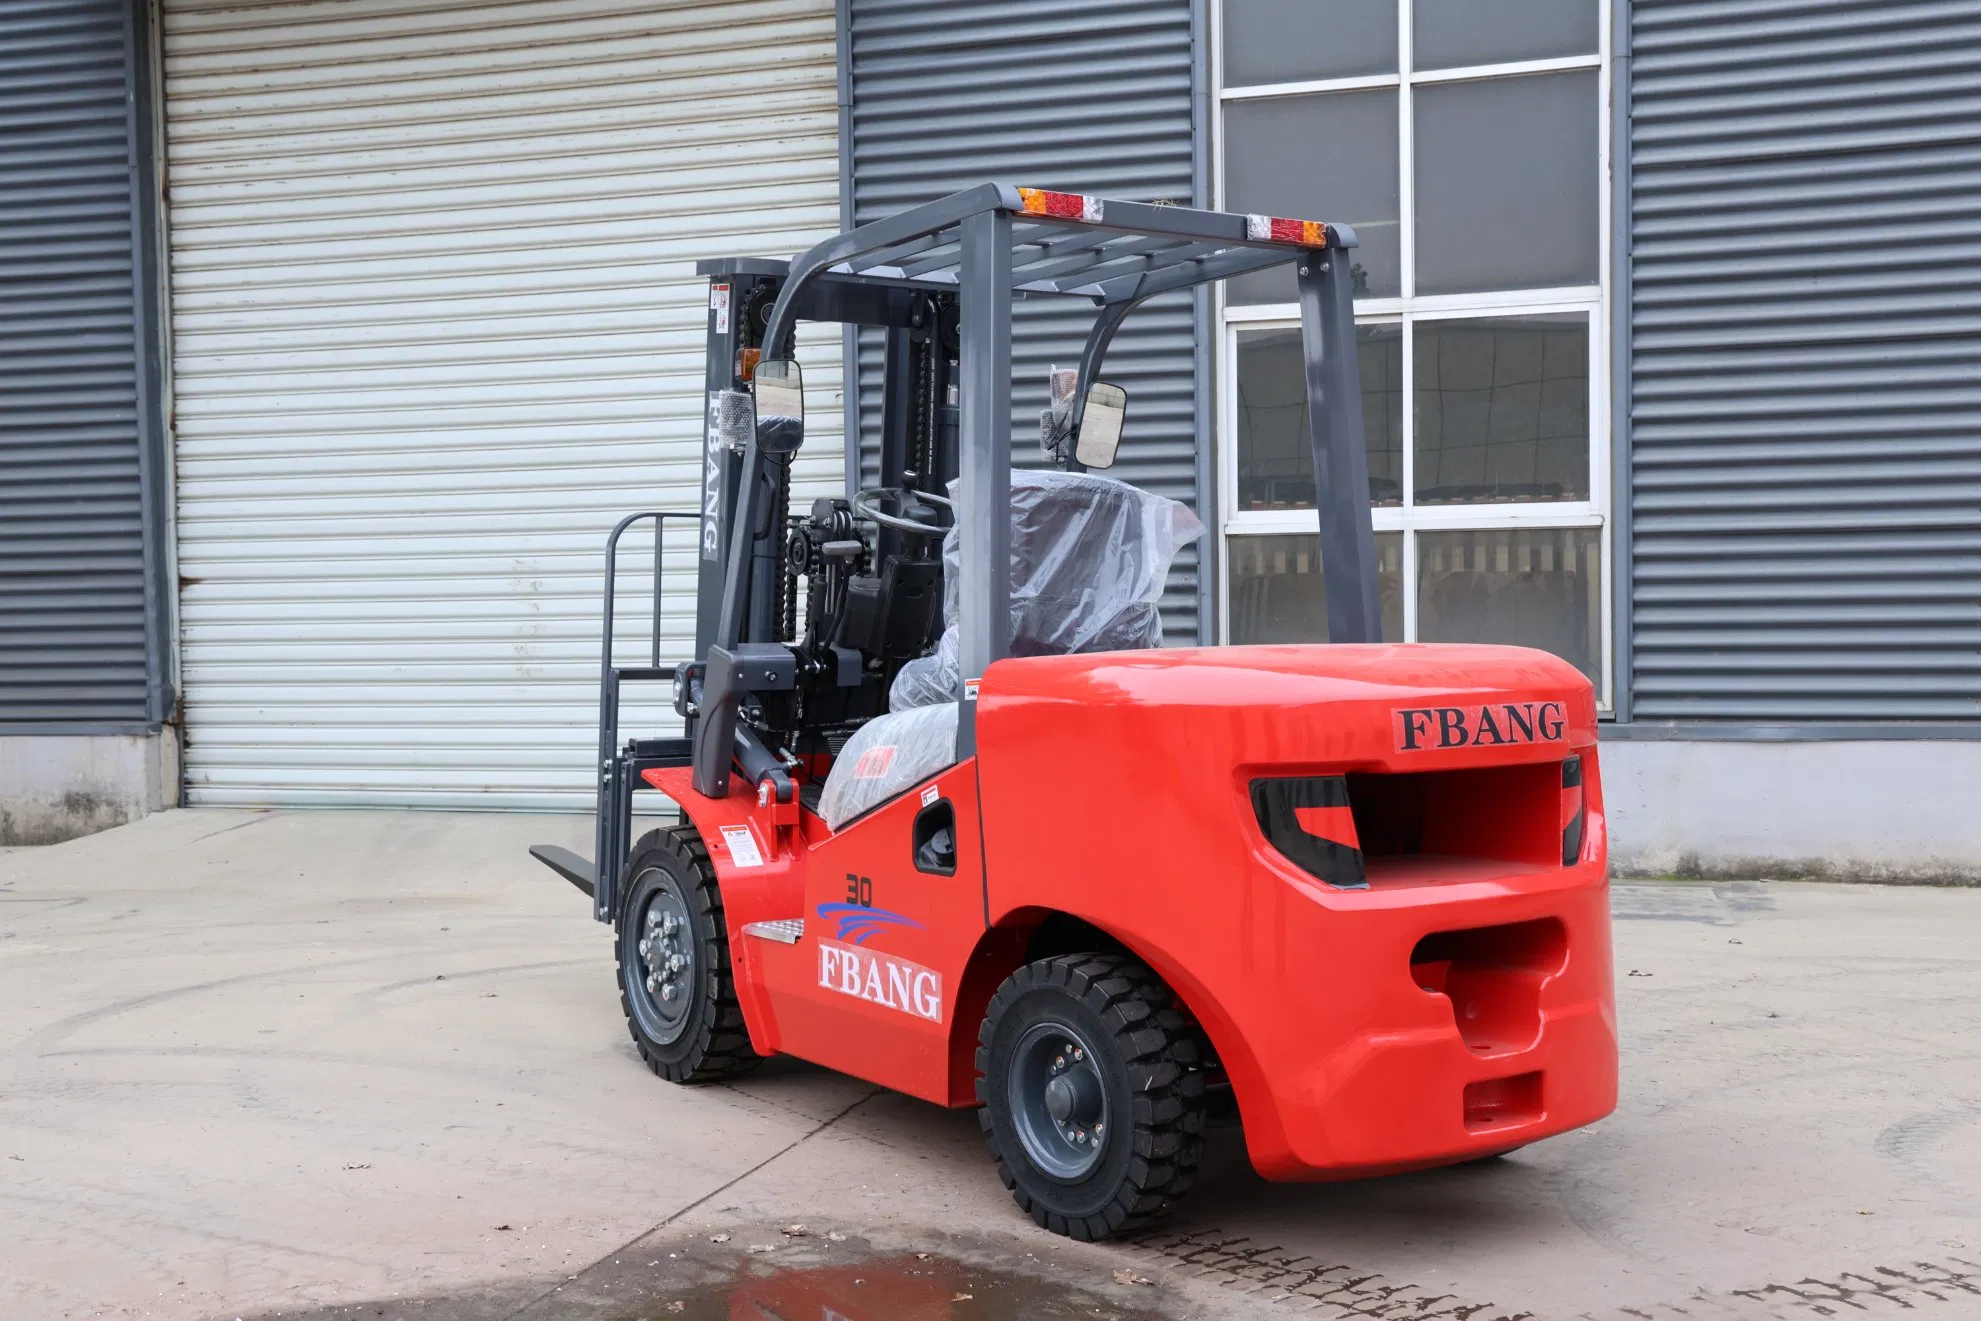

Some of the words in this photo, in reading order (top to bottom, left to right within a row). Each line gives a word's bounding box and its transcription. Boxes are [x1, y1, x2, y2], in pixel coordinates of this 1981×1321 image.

[704, 394, 720, 553] FBANG
[1397, 703, 1564, 750] FBANG
[846, 873, 872, 908] 30
[819, 944, 940, 1019] FBANG
